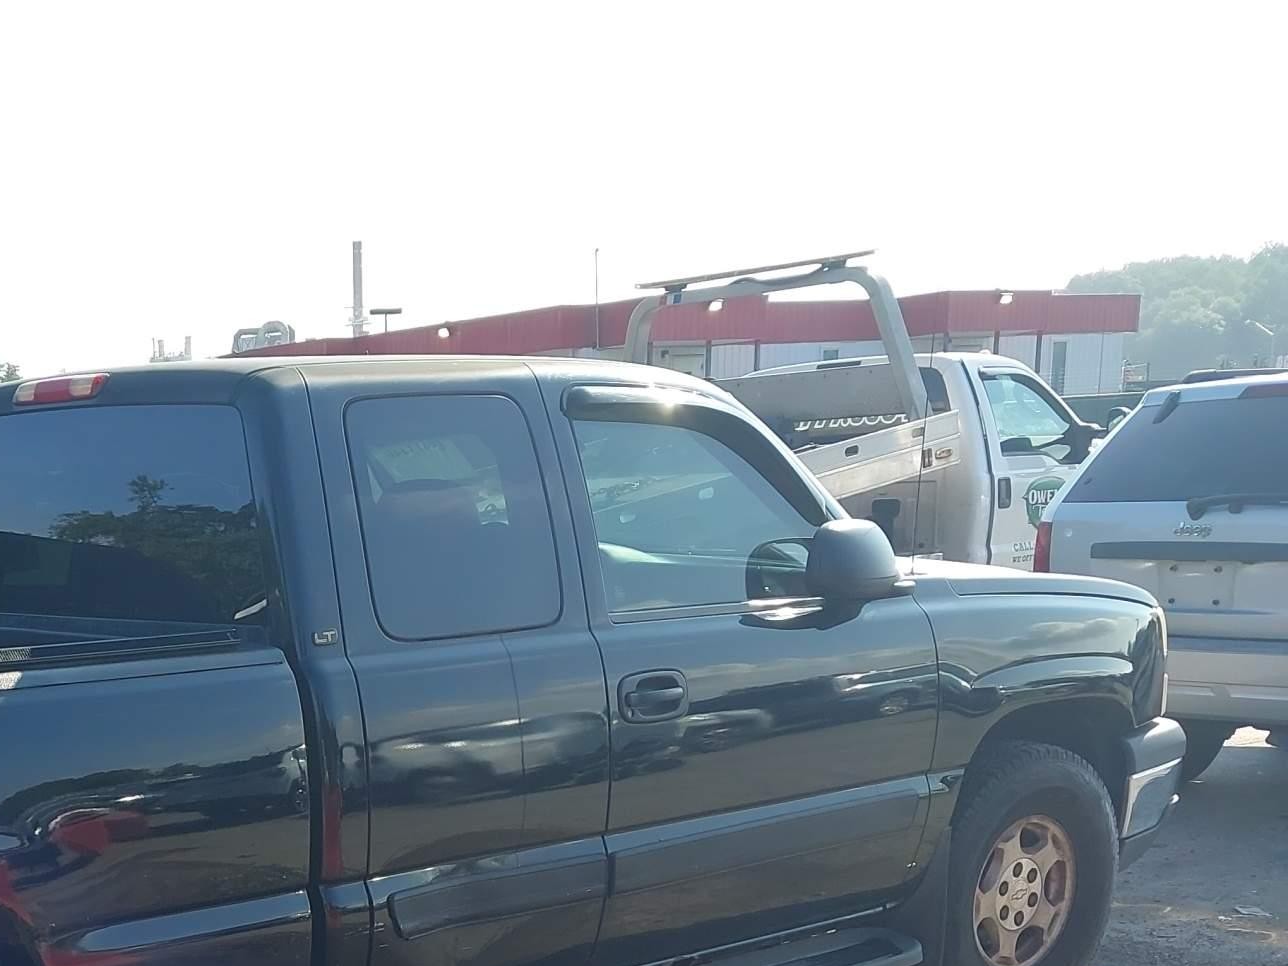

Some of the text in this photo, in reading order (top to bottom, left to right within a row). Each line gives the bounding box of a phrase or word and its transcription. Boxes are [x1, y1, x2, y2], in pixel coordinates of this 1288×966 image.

[1173, 521, 1213, 538] Jeep
[1013, 541, 1033, 552] CALL
[314, 630, 336, 645] LT
